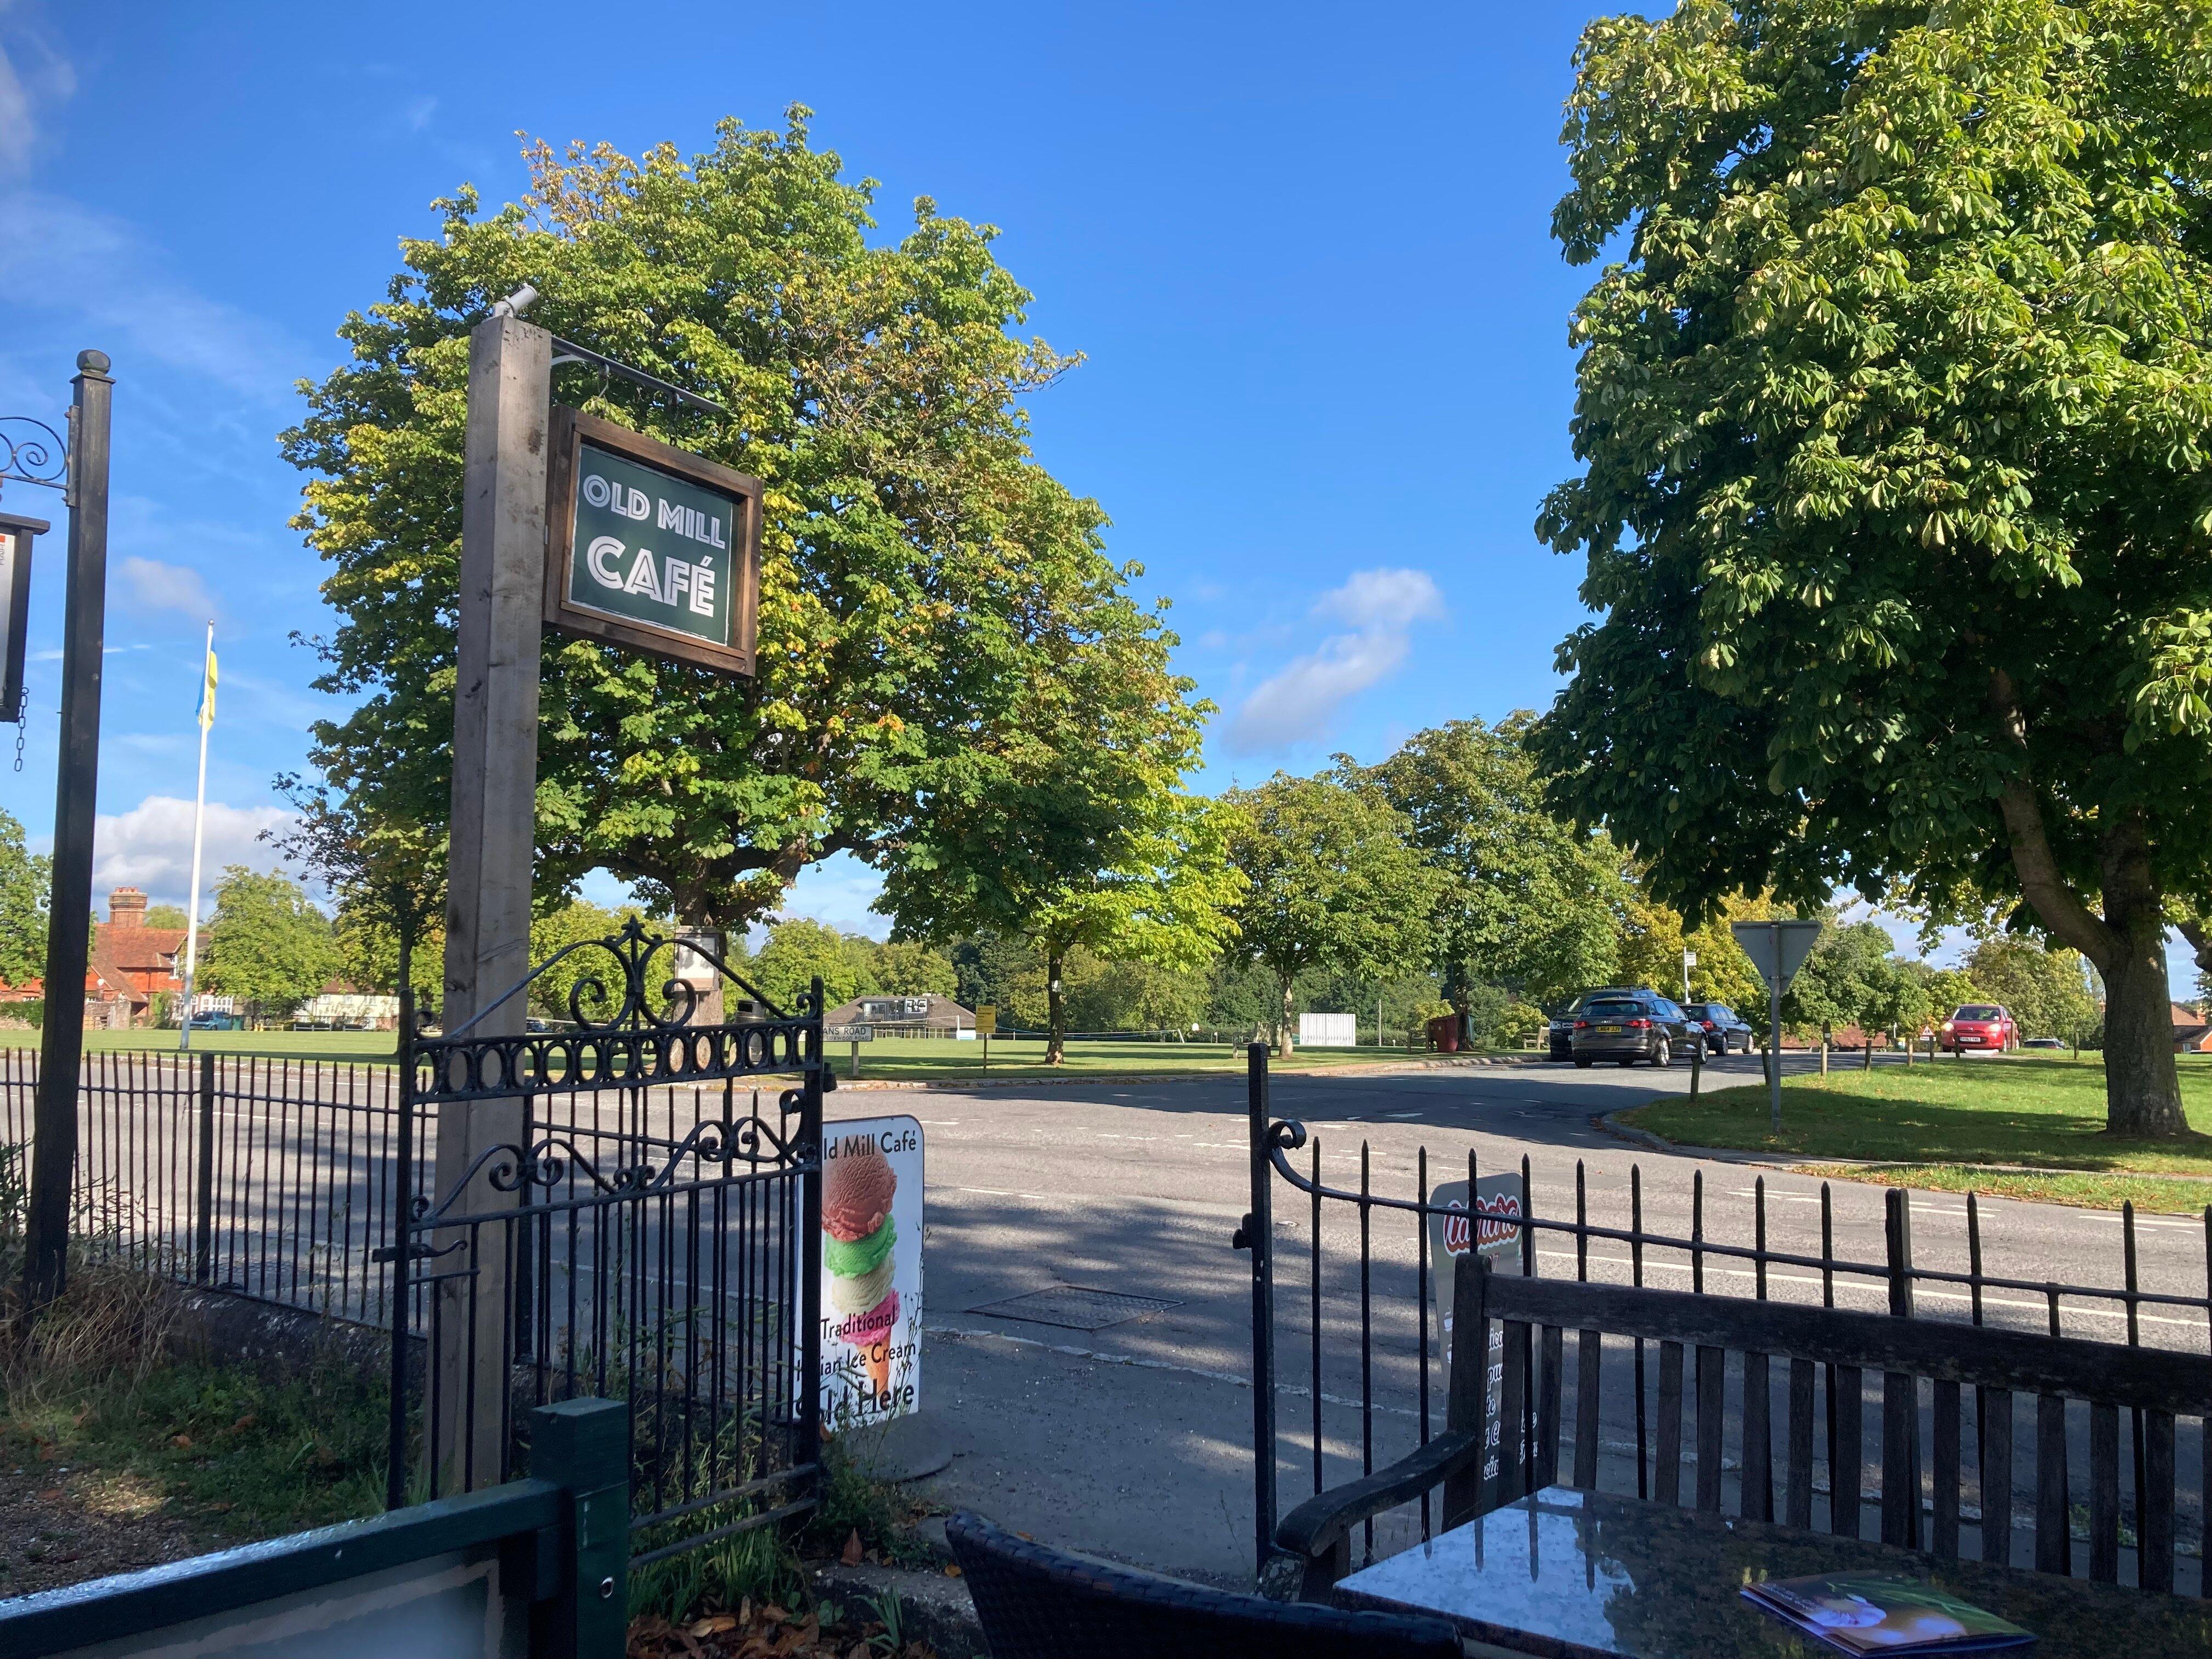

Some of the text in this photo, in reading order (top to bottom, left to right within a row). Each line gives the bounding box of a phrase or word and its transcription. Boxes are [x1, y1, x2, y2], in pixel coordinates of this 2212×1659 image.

[583, 475, 725, 550] OLD MILL
[587, 535, 715, 617] CAFÉ
[823, 1130, 916, 1160] ld Mill Café
[821, 1305, 895, 1339] Traditional
[871, 1342, 916, 1363] Cream
